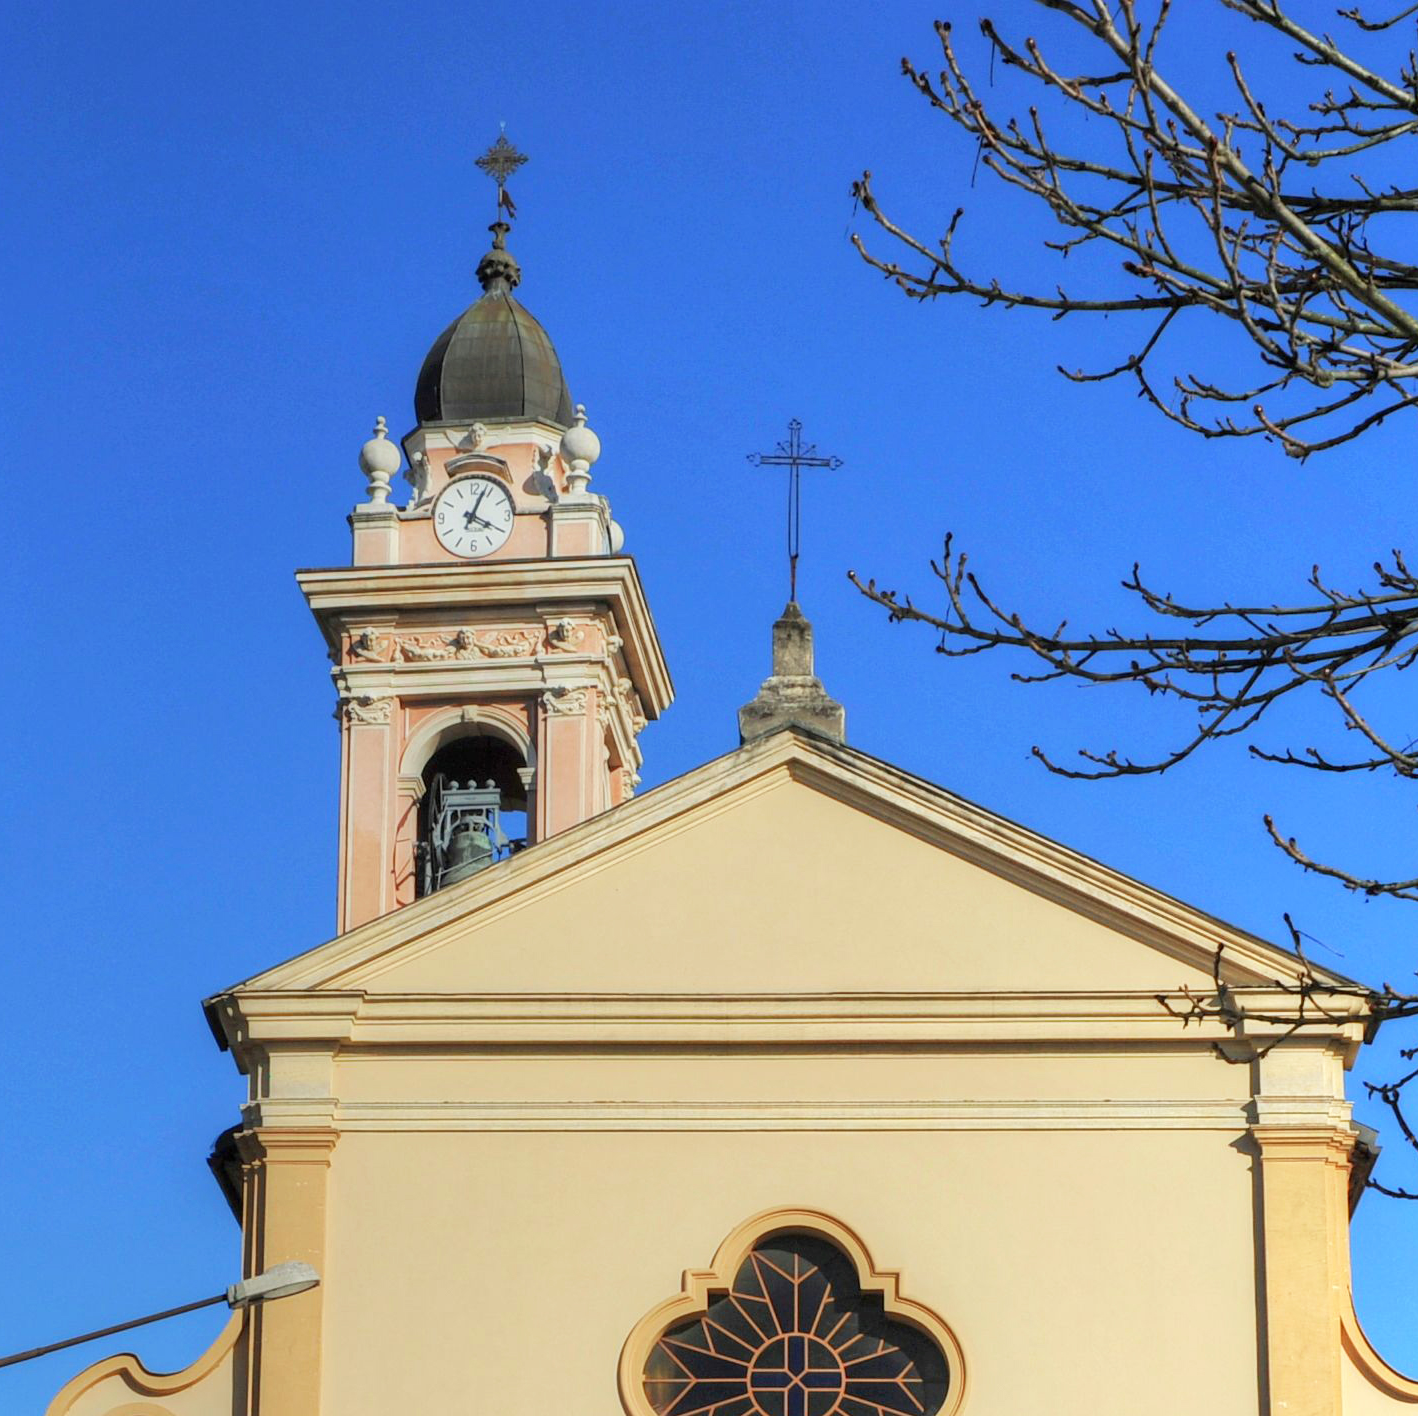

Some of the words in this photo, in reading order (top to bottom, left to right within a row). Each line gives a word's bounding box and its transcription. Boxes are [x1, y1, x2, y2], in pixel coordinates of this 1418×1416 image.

[470, 483, 480, 495] 12
[438, 512, 445, 525] 9
[504, 510, 511, 522] 3
[470, 539, 478, 552] 6
